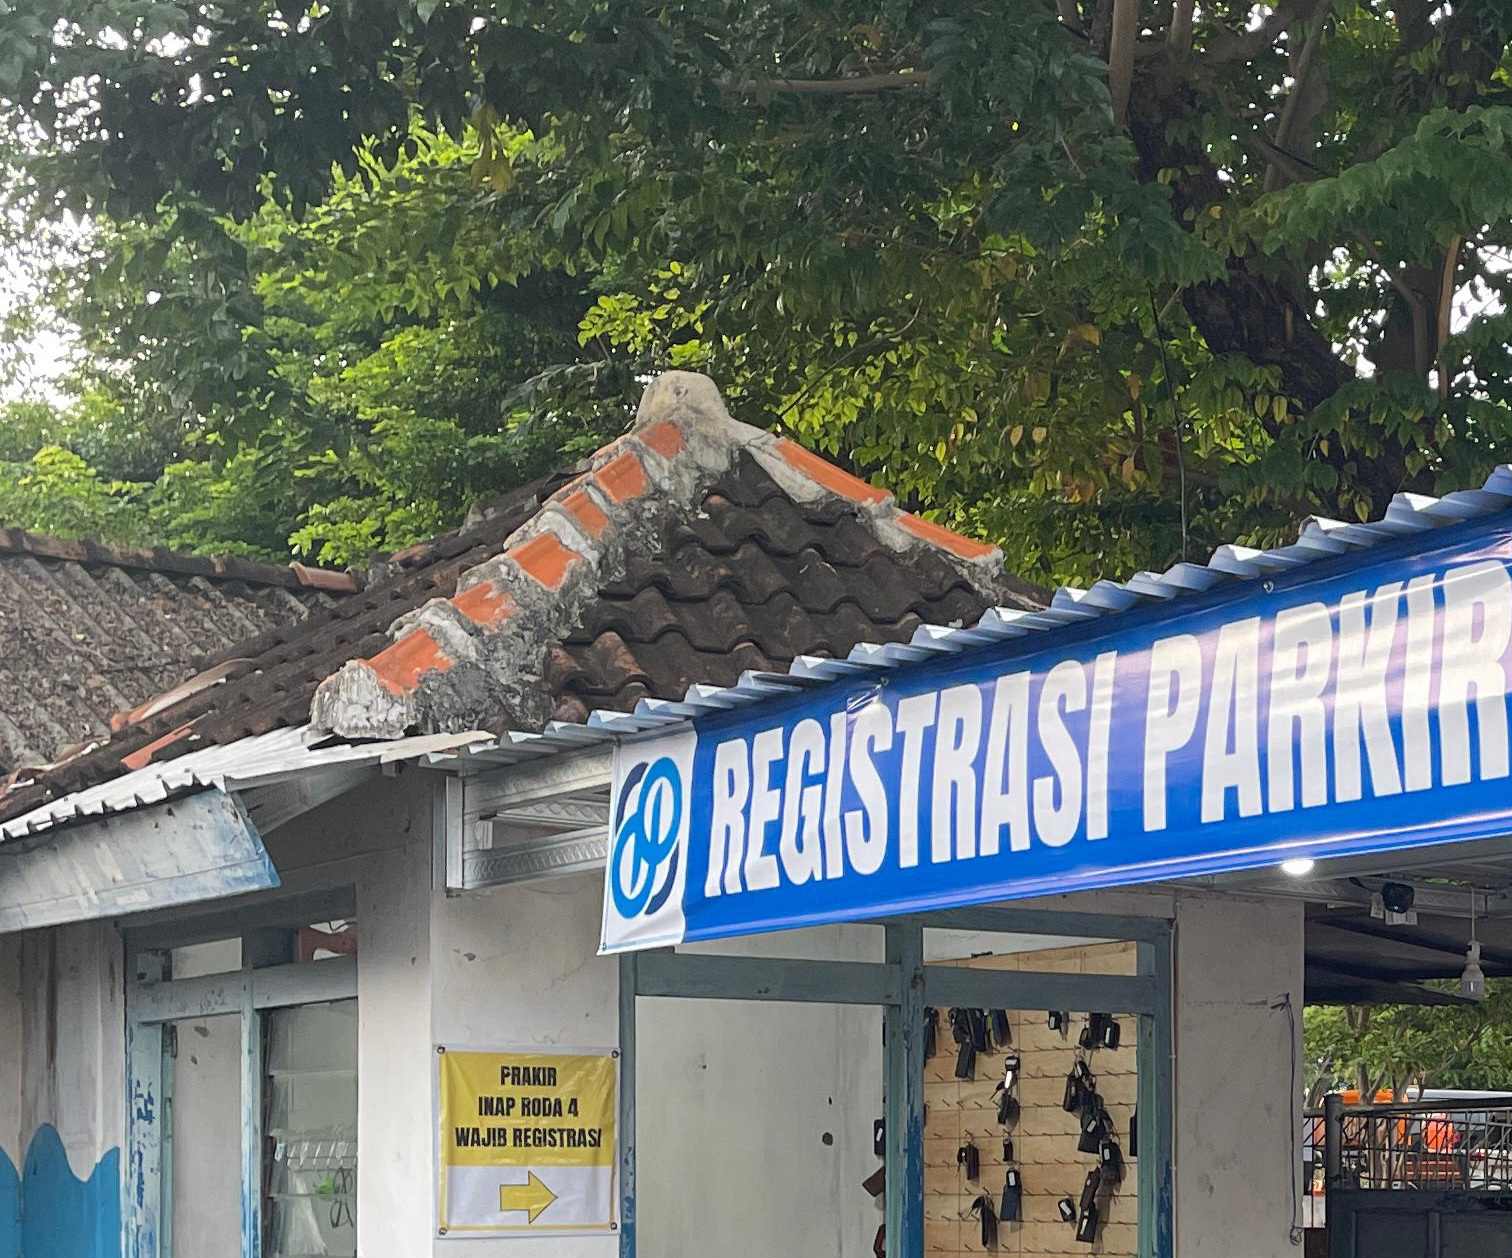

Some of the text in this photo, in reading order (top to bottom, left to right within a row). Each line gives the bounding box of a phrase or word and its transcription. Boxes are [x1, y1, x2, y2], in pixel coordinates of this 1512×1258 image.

[704, 649, 1117, 898] REGISTRASI
[1143, 558, 1512, 832] PARKIR
[500, 1066, 557, 1087] PRAKIR
[478, 1096, 579, 1118] INAP RODA 4
[455, 1127, 602, 1148] WAJIB REGISTRASI
